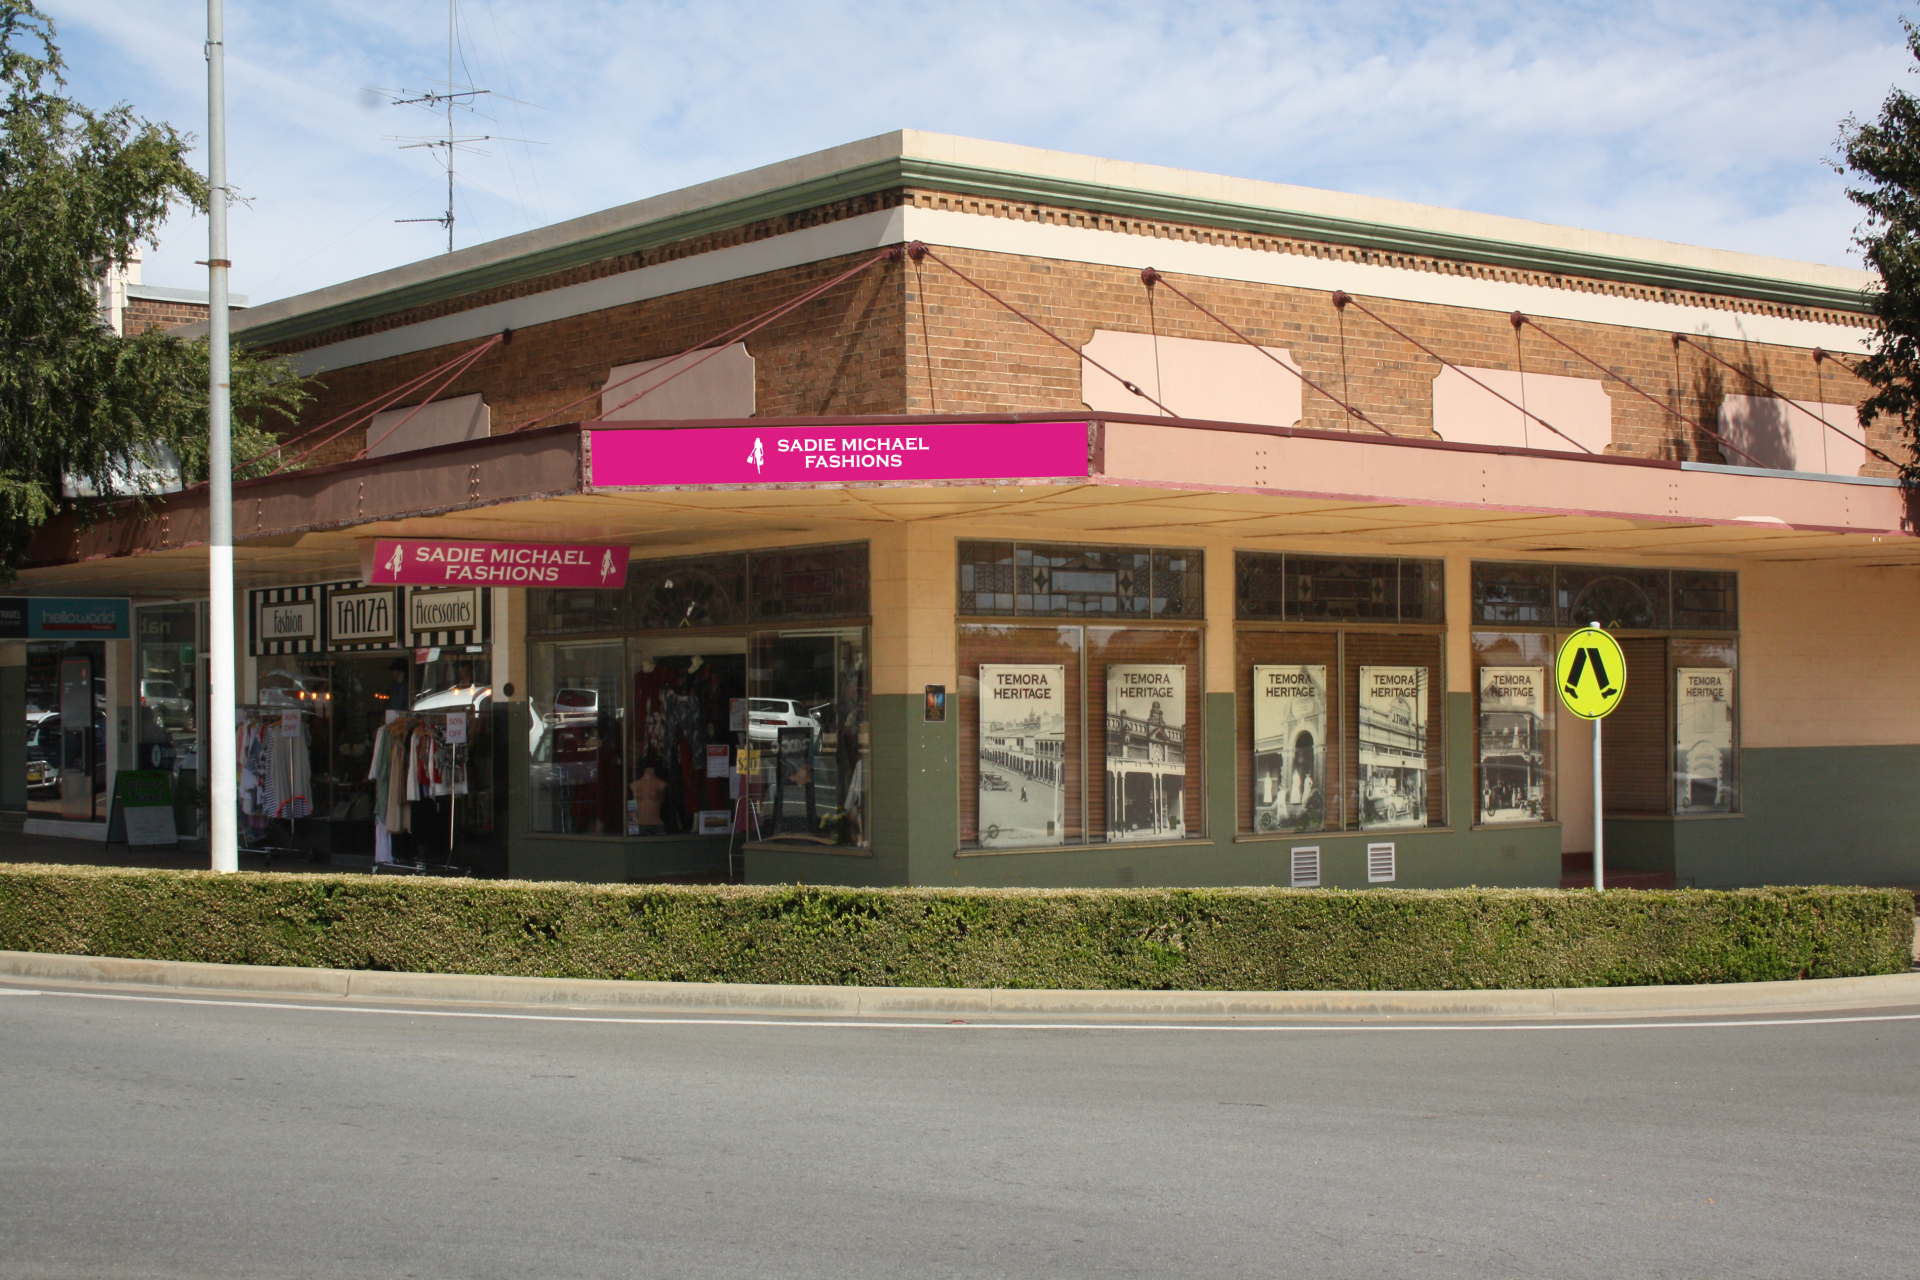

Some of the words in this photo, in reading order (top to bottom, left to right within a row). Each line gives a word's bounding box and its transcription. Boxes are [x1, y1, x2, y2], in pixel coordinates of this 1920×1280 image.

[777, 438, 836, 452] SADIE
[842, 437, 930, 451] MICHAEL
[804, 454, 903, 468] FASHIONS
[416, 547, 485, 563] SADIE
[490, 549, 591, 565] MICHAEL
[445, 565, 559, 582] FASHIONS
[337, 597, 388, 635] TANZA
[415, 596, 471, 625] Accessories
[42, 610, 116, 624] helloworld
[273, 609, 303, 634] Fashion
[997, 674, 1048, 685] TEMORA
[1123, 673, 1170, 684] TEMORA
[1269, 674, 1312, 684] TEMORA
[1374, 675, 1415, 685] TEMORA
[1493, 675, 1531, 685] TEMORA
[1688, 676, 1722, 686] TEMORA
[993, 688, 1052, 699] HERITAGE
[1120, 687, 1174, 698] HERITAGE
[1266, 687, 1315, 697] HERITAGE
[1370, 687, 1417, 698] HERITAGE
[1491, 687, 1534, 697] HERITAGE
[1686, 688, 1724, 697] HERITAGE
[284, 713, 298, 721] 30%
[449, 717, 464, 725] 50%
[449, 729, 462, 737] OFF
[124, 779, 167, 790] Temora
[129, 792, 164, 802] Travel
